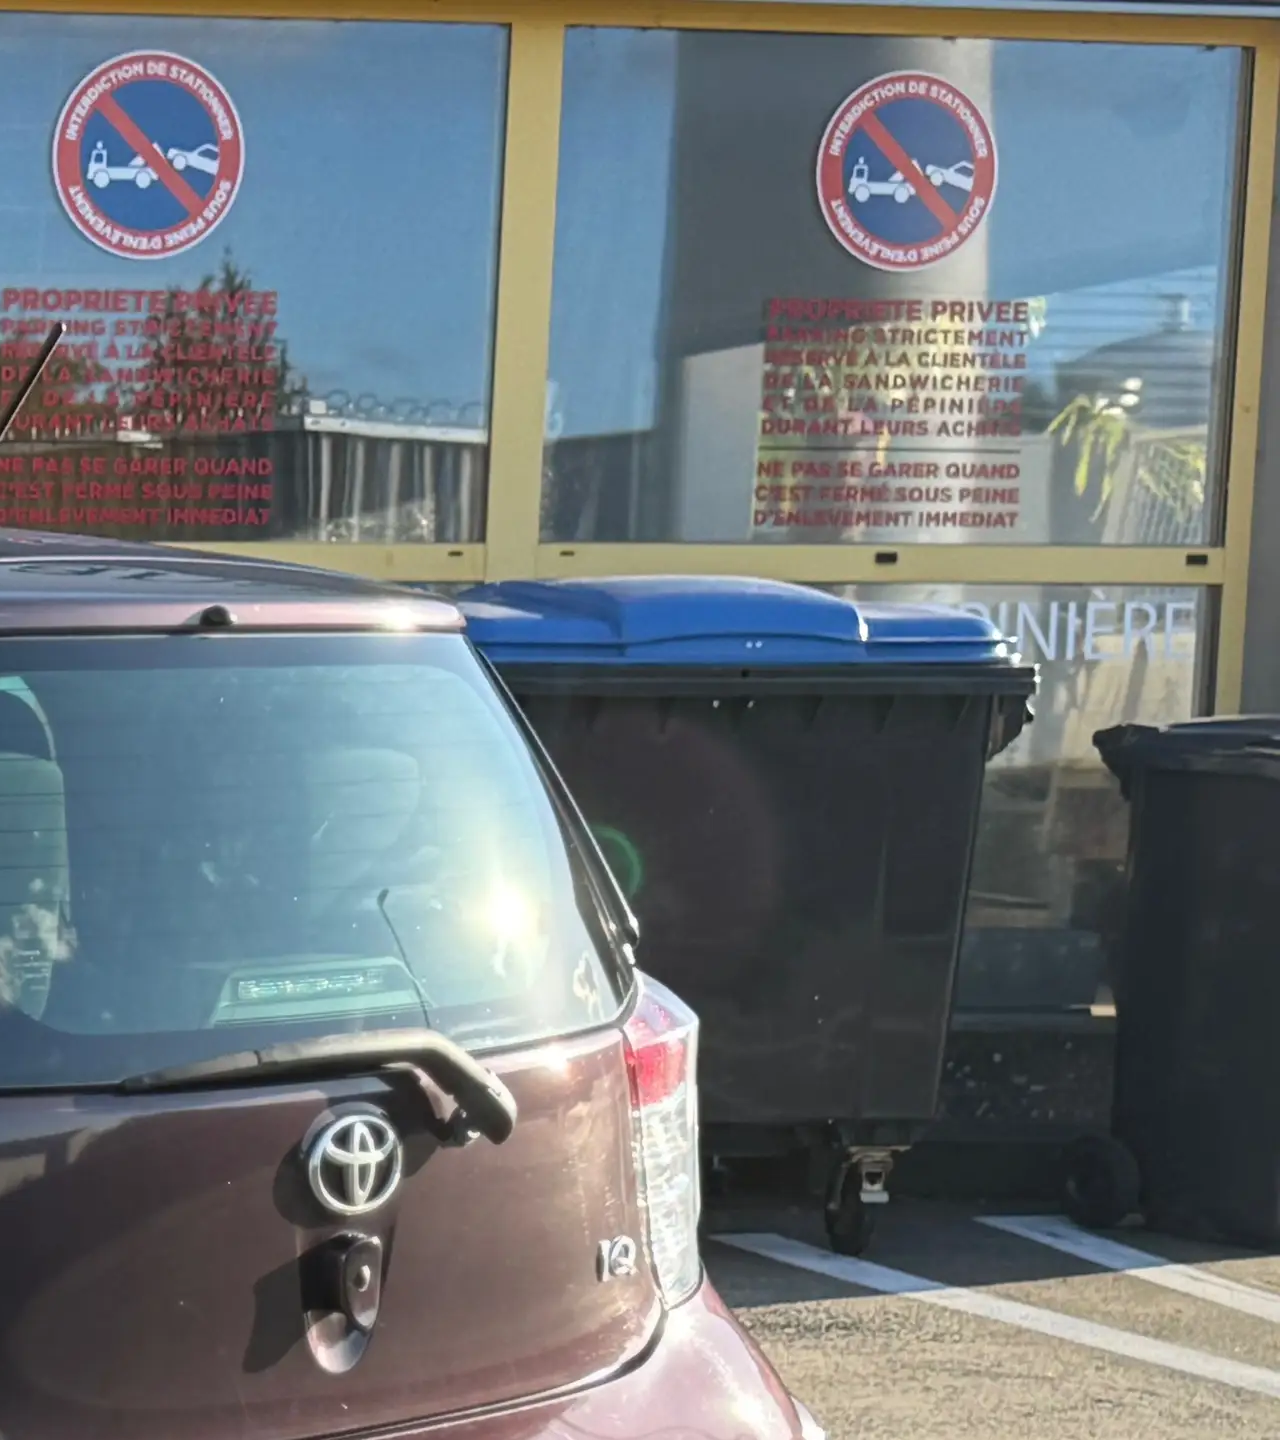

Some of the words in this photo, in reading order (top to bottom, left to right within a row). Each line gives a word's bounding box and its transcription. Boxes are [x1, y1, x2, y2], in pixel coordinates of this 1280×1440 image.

[66, 61, 143, 141] INTERDICTION
[147, 61, 168, 77] DE
[170, 64, 233, 141] STATIONNER
[829, 81, 906, 157] INTERDICTION
[909, 81, 929, 95] DE
[205, 179, 232, 215] SOUS
[957, 196, 985, 234] SOUS
[2, 287, 168, 315] PROPRIETE
[174, 288, 278, 316] PRIVEE
[769, 297, 923, 323] PROPRIETE
[930, 299, 1029, 323] PRIVEE
[873, 327, 1028, 347] STRICTEMENT
[126, 343, 155, 361] LA
[884, 349, 911, 367] LA
[42, 367, 71, 384] LA
[803, 373, 834, 392] LA
[843, 373, 1026, 394] SANDWICHERIE
[847, 396, 880, 413] LA
[13, 412, 95, 432] URANT
[761, 418, 856, 436] DURANT
[859, 419, 929, 437] LEURS
[32, 456, 74, 474] PAS
[80, 456, 107, 475] SE
[113, 457, 188, 476] GARER
[193, 457, 273, 476] QUAND
[757, 460, 784, 478] NE
[791, 461, 833, 478] PAS
[838, 461, 863, 478] SE
[868, 461, 940, 479] GARER
[945, 462, 1021, 480] QUAND
[142, 482, 203, 500] SOUS
[208, 483, 274, 501] PEINE
[755, 484, 814, 502] C'EST
[894, 486, 953, 503] SOUS
[958, 486, 1020, 504] PEINE
[167, 507, 271, 526] IMMEDIAT
[918, 511, 1019, 529] IMMEDIAT
